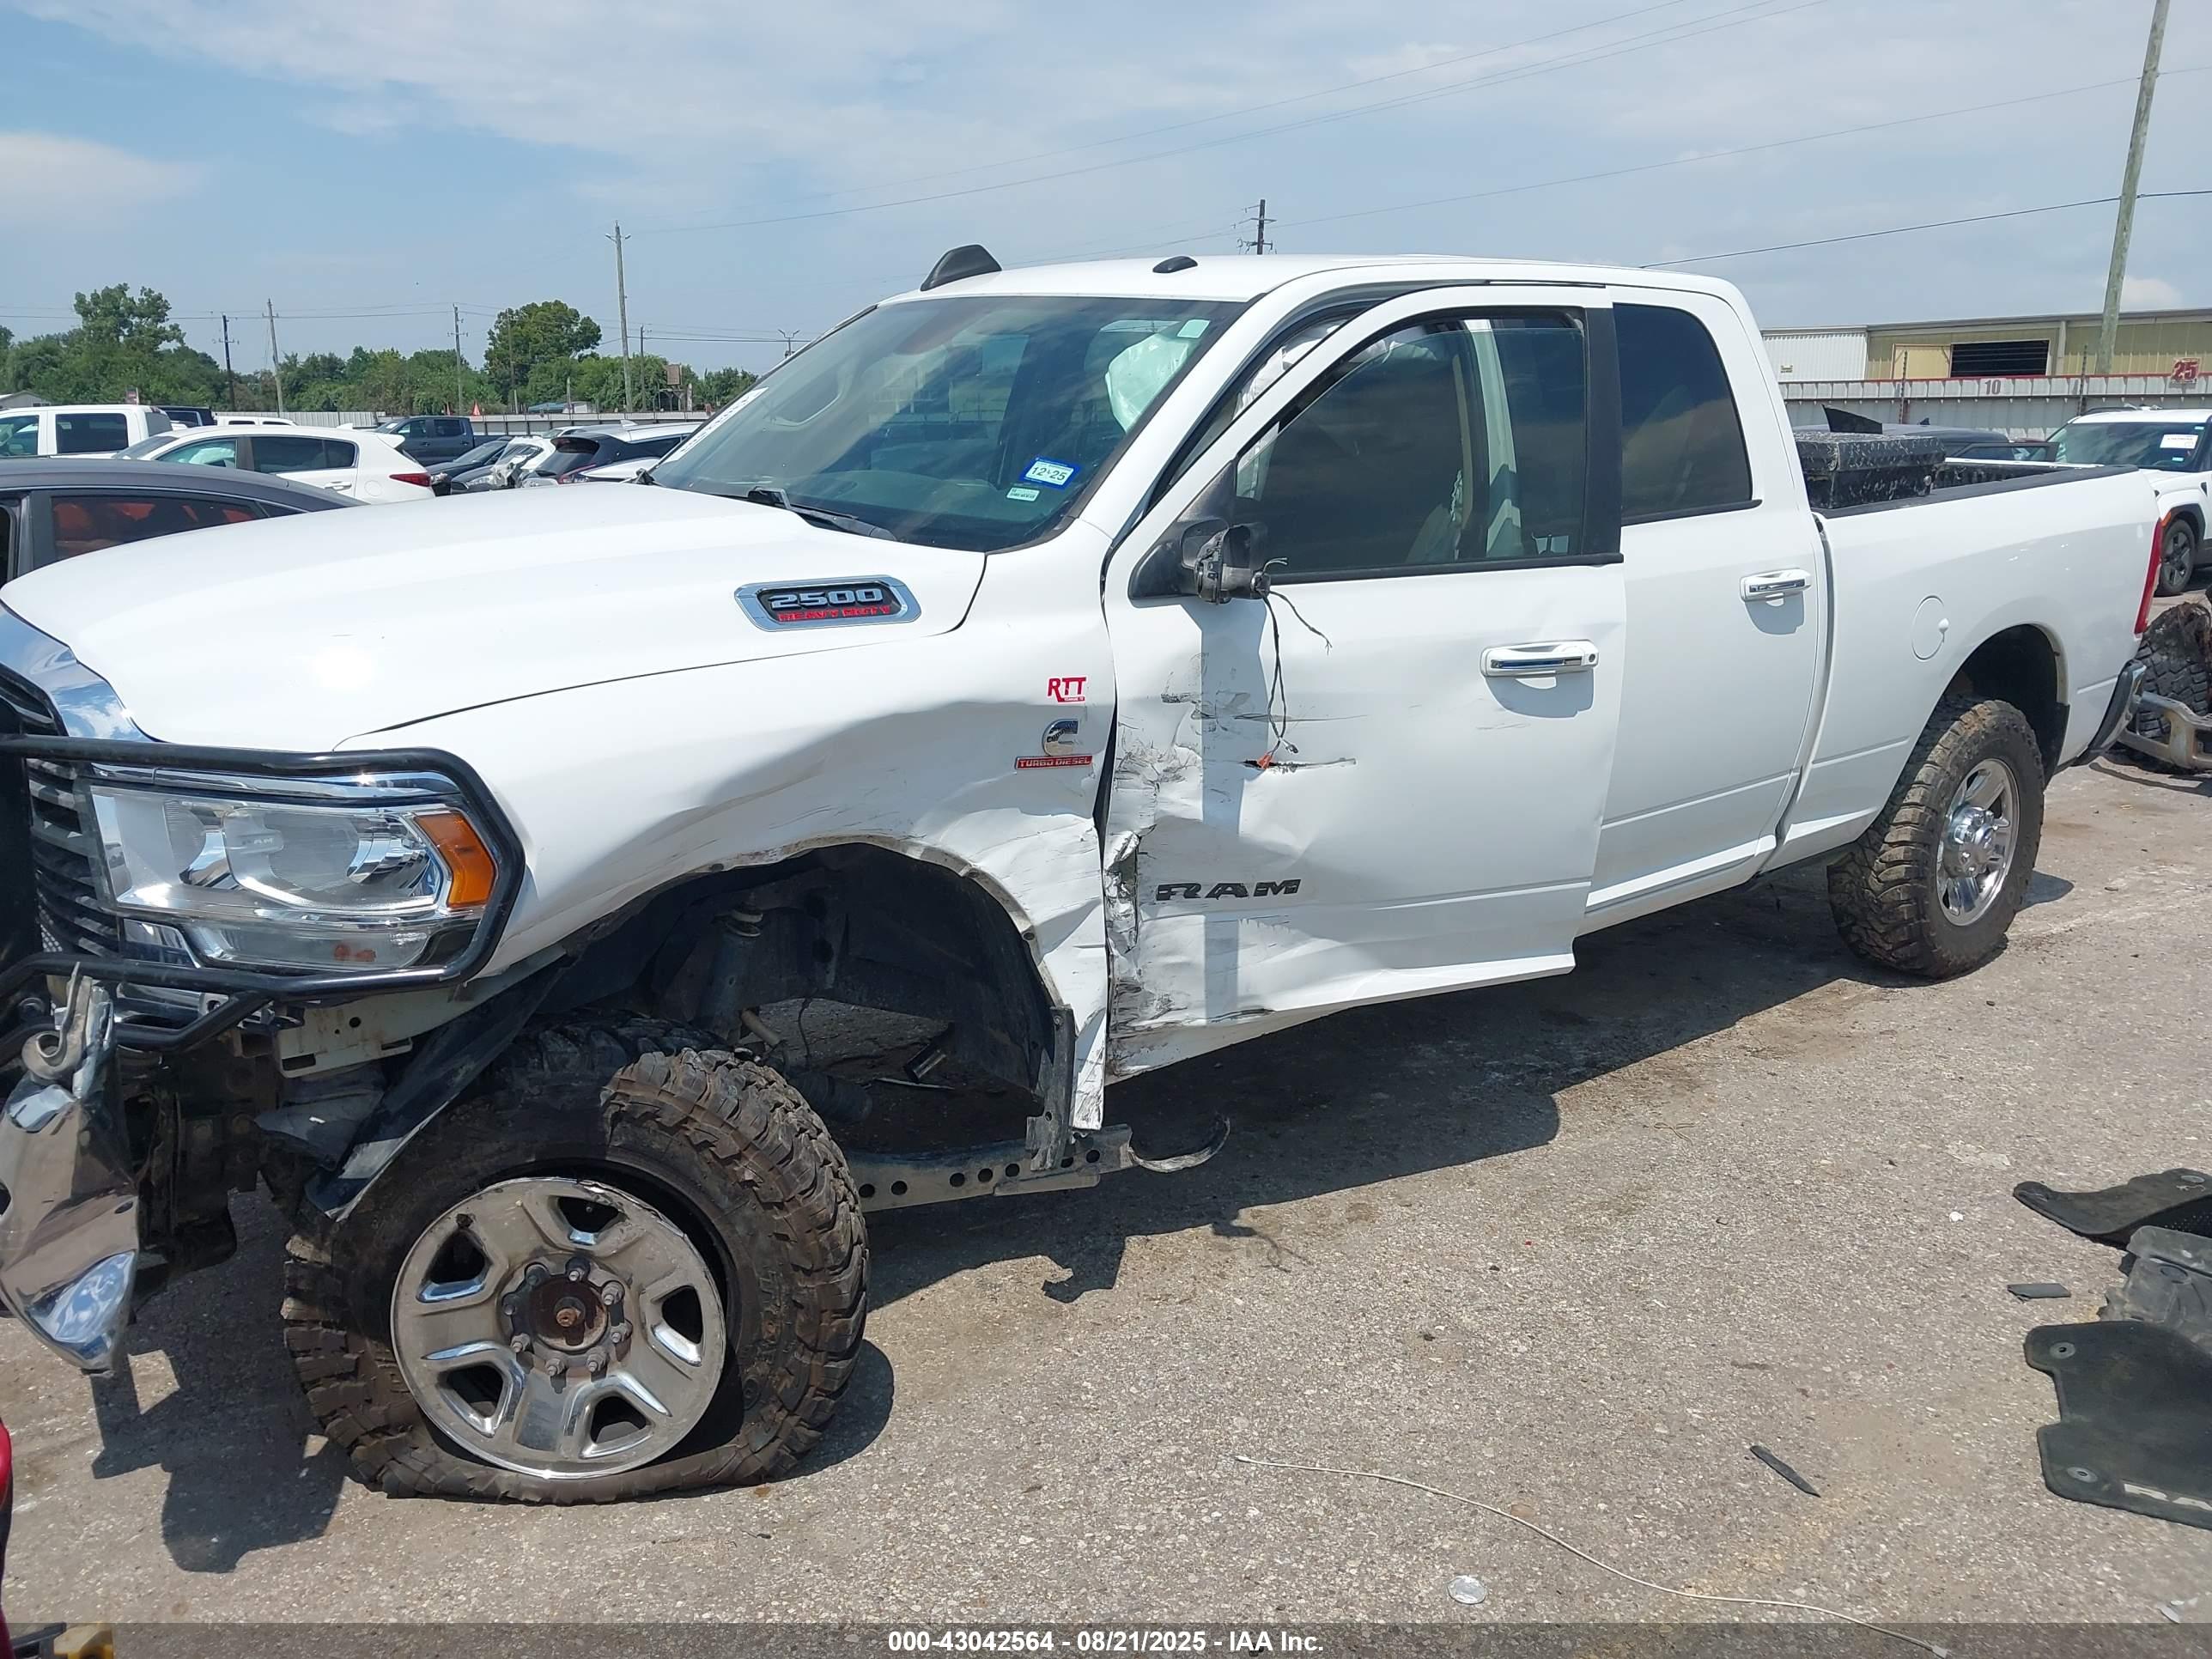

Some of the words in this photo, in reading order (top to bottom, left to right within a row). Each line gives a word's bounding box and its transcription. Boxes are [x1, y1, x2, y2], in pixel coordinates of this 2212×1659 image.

[2172, 361, 2198, 382] 25
[1984, 380, 2002, 395] 10
[1031, 466, 1048, 477] 12
[1049, 470, 1067, 481] 25
[769, 590, 883, 610] 2500
[778, 610, 839, 622] HEAVY
[842, 605, 890, 617] DUTY
[1047, 677, 1087, 702] RTT
[1019, 758, 1054, 768] TURBO
[1054, 756, 1091, 766] DIESEL
[1155, 878, 1302, 902] RAM
[2124, 1483, 2212, 1511] RA
